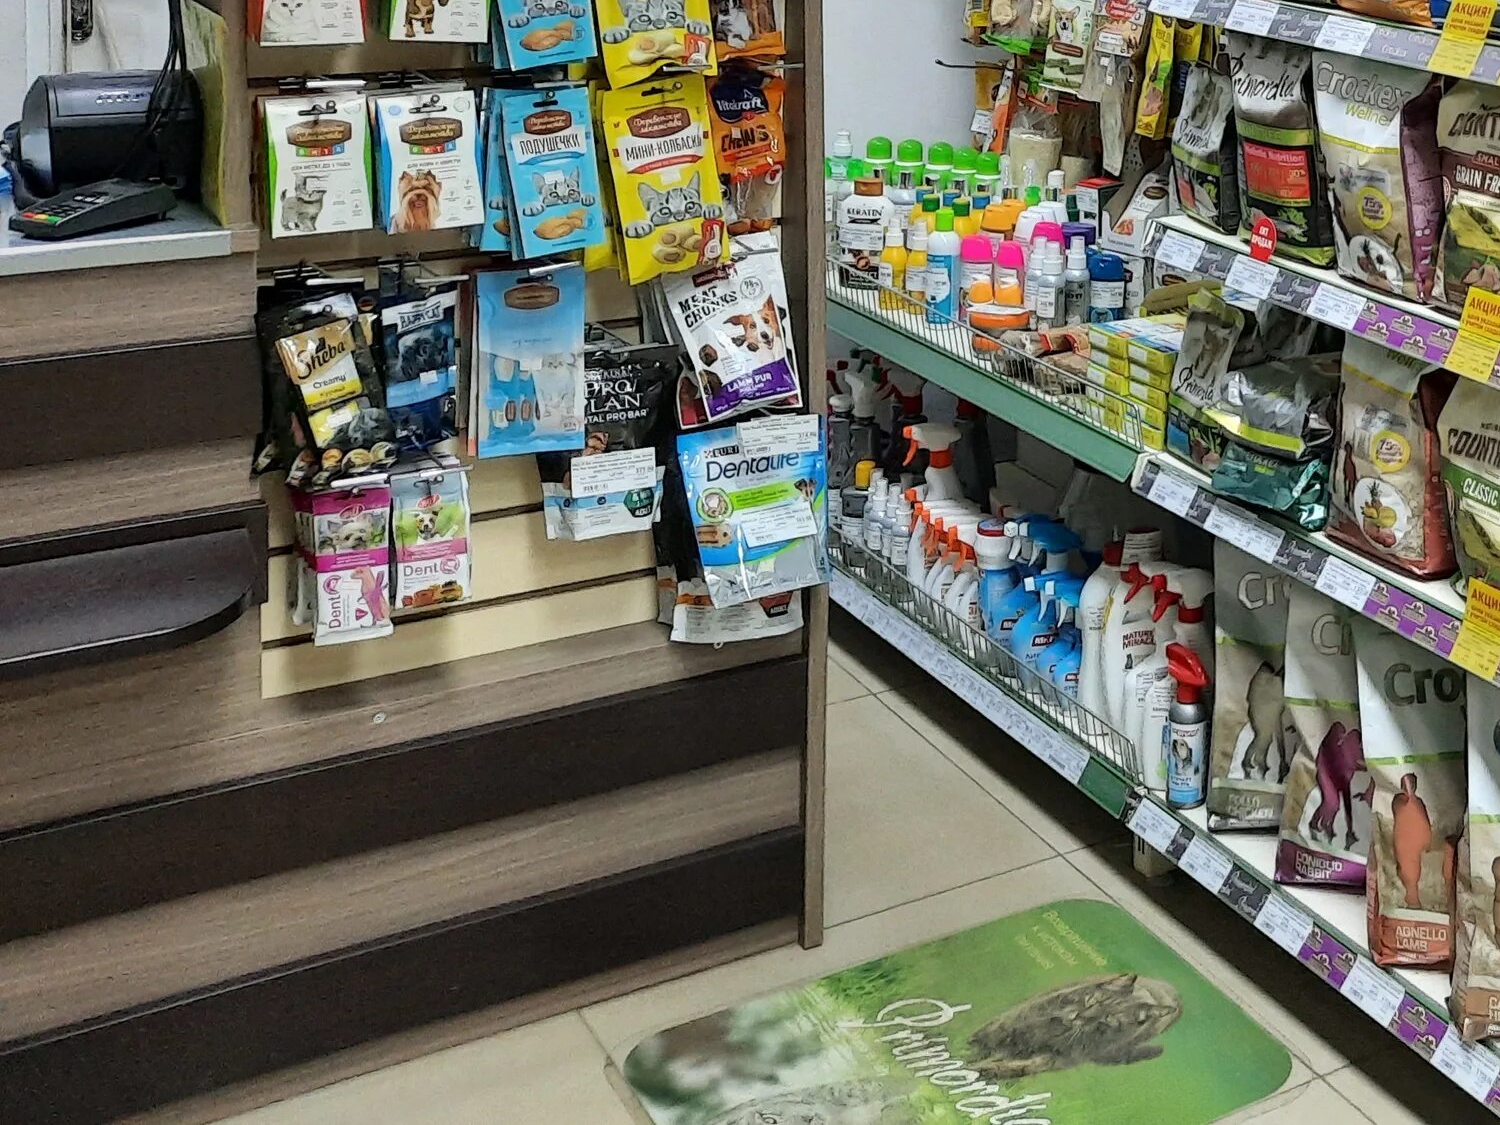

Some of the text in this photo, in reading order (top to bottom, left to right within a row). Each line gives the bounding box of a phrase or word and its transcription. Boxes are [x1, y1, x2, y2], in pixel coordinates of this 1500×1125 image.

[1453, 0, 1491, 20] АКЦИЯ!
[1317, 59, 1412, 115] Crockex
[519, 133, 581, 156] ПОДУШЕЧКИ
[1455, 166, 1482, 189] GRAIN
[846, 207, 883, 219] KERATIN
[296, 339, 346, 381] Sheba
[1462, 477, 1499, 511] CLASSIC
[403, 562, 440, 577] Dent
[1394, 924, 1447, 943] AGNELLO
[1395, 938, 1429, 952] LAMB
